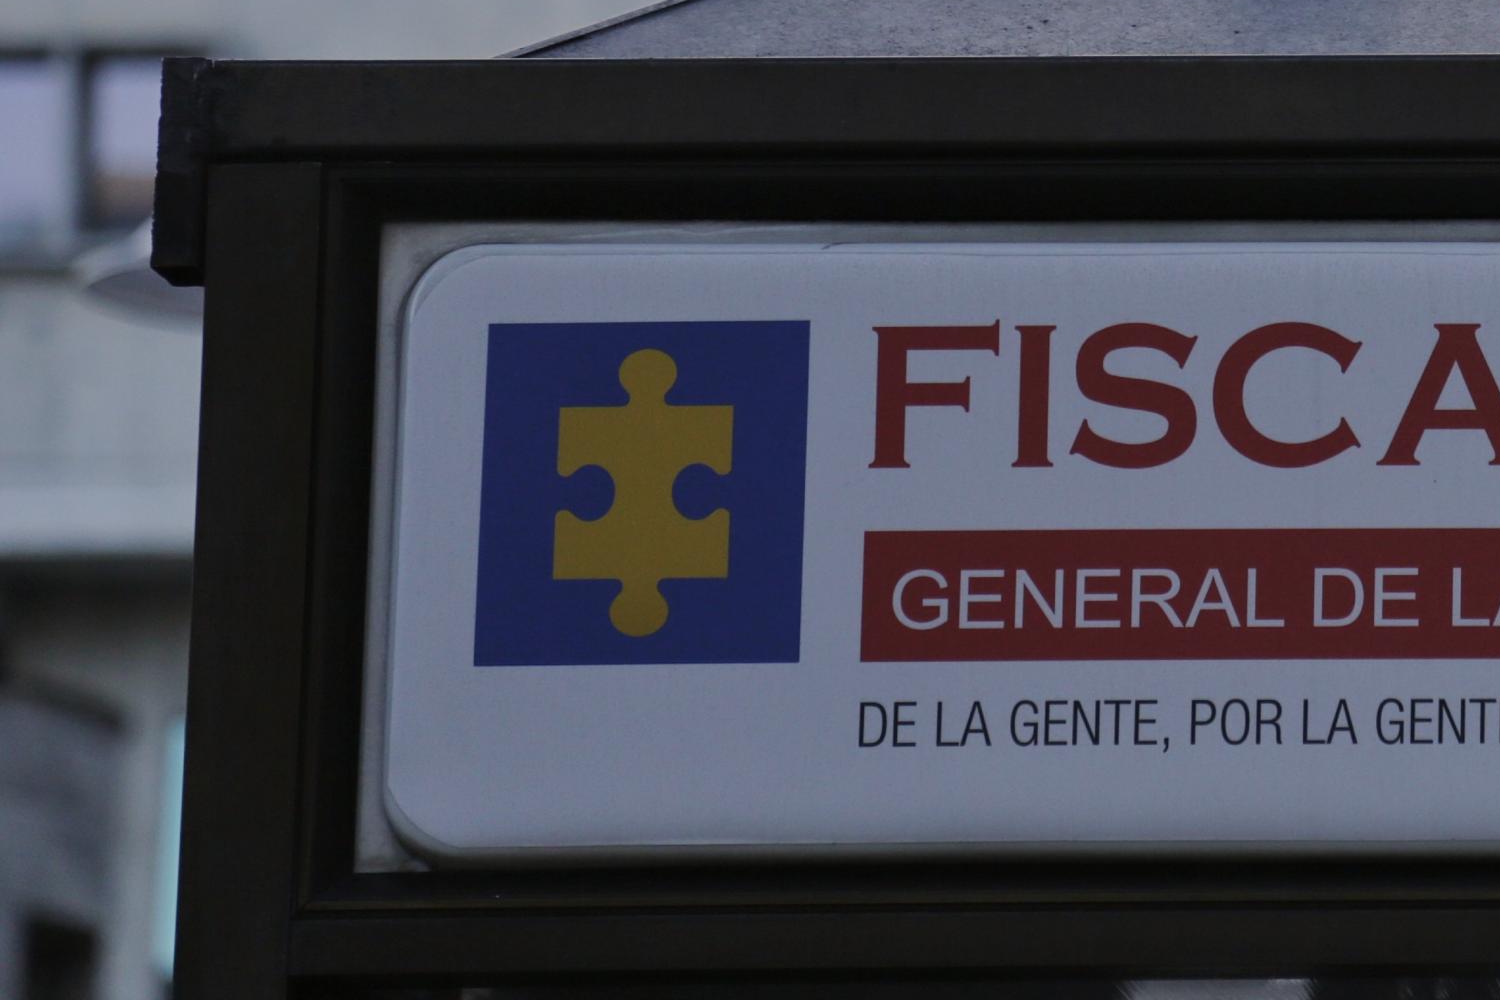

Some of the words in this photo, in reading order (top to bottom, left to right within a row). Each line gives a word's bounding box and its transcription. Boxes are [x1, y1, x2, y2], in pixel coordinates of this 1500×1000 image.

[893, 568, 1284, 630] GENERAL
[1314, 568, 1419, 627] DE
[859, 702, 917, 747] DE
[936, 701, 991, 746] LA
[1010, 700, 1169, 752] GENTE,
[1191, 699, 1282, 745] POR
[1303, 699, 1357, 744] LA
